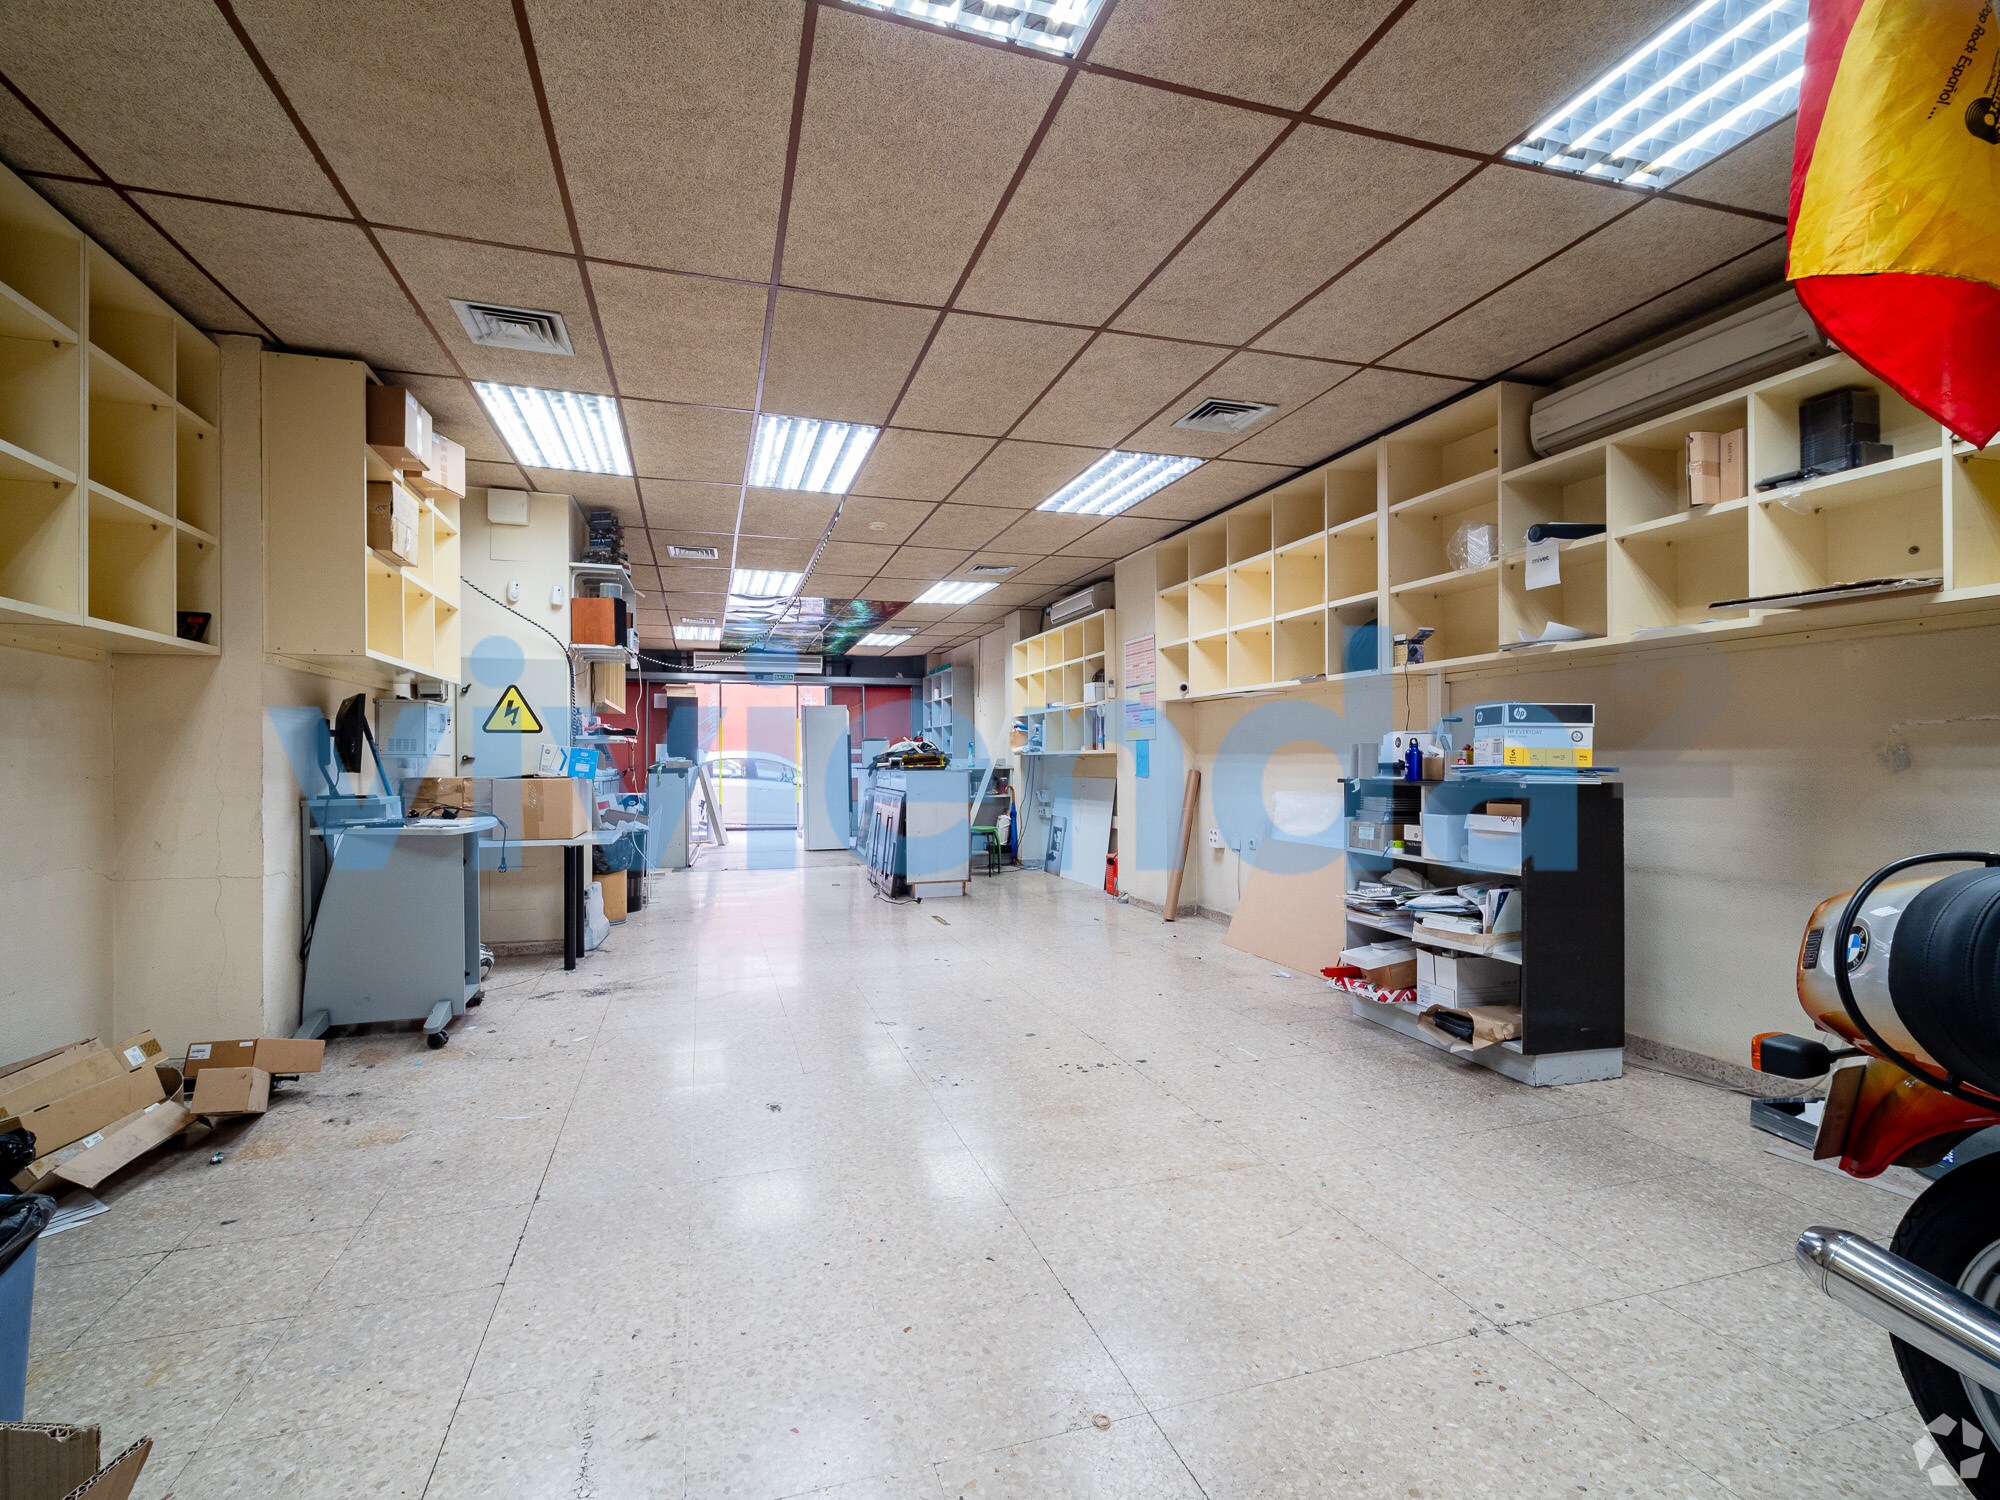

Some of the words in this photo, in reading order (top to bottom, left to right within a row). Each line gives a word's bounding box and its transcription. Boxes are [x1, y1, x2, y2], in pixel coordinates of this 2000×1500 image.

[1978, 0, 1993, 24] Pop
[1964, 24, 1985, 54] Rock
[1936, 54, 1973, 106] Español
[1514, 707, 1526, 719] hp
